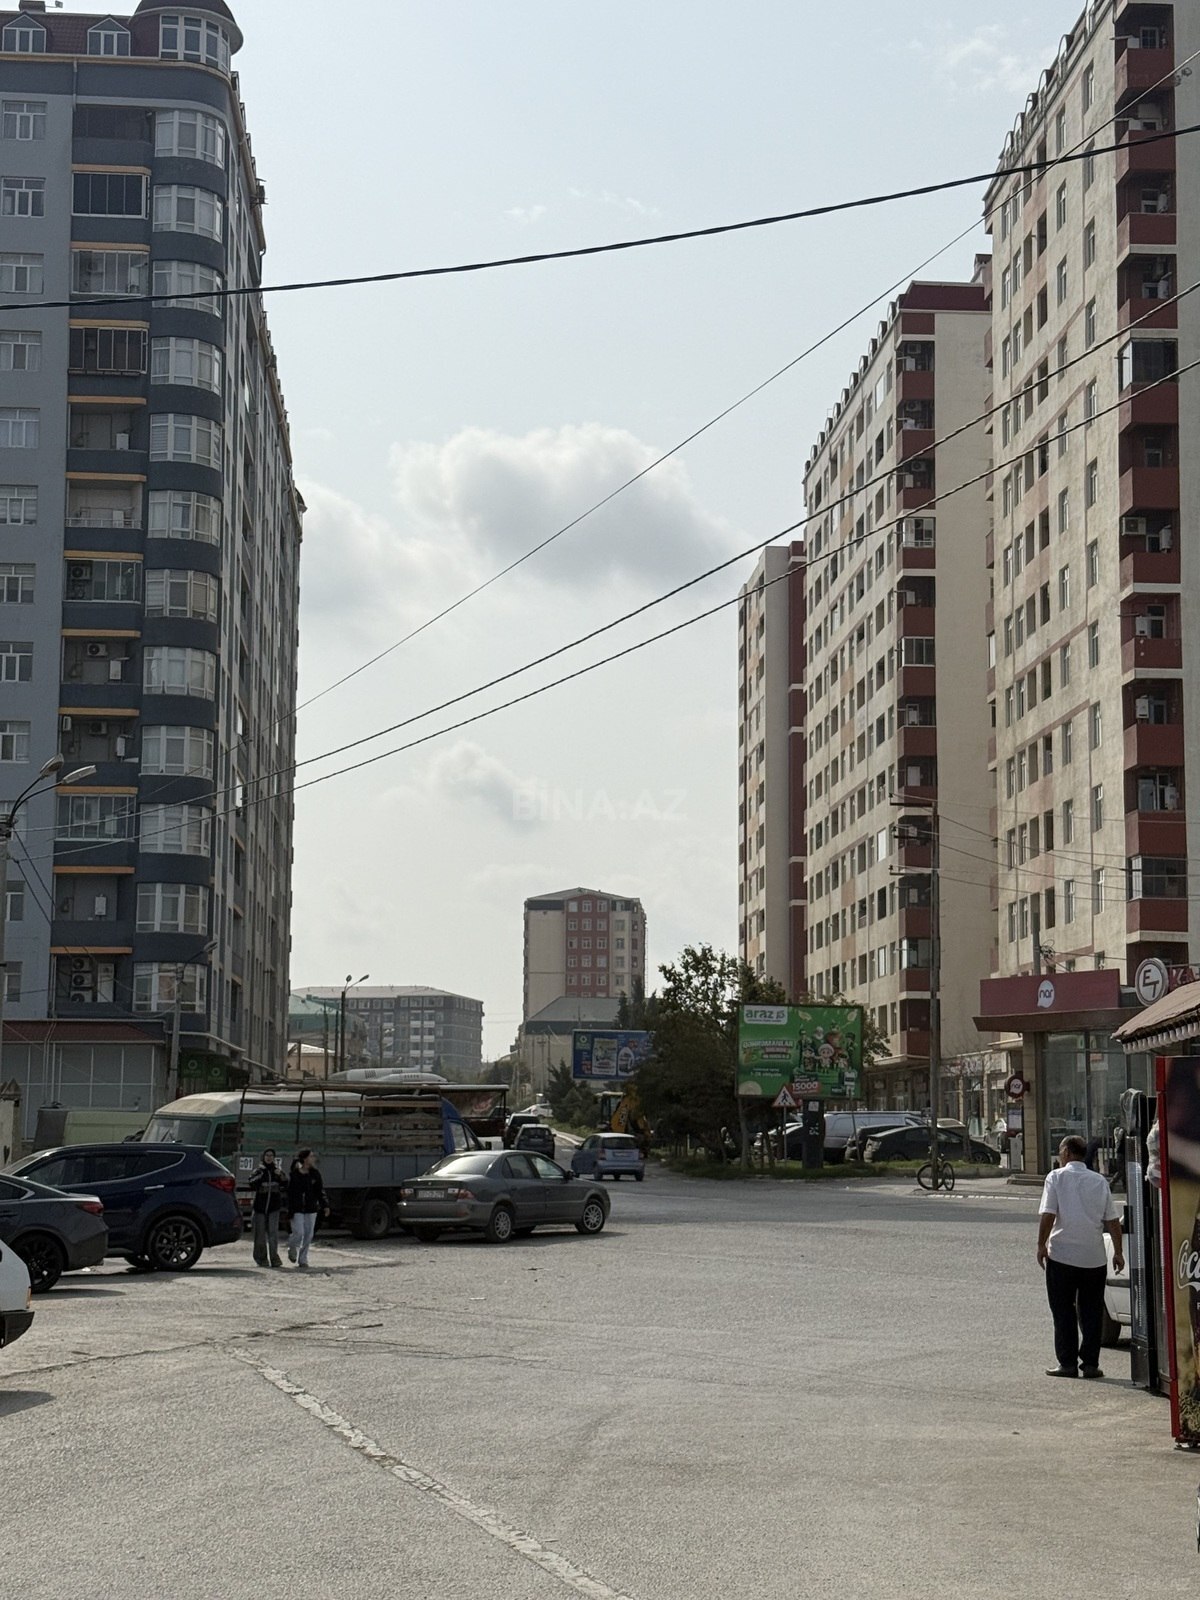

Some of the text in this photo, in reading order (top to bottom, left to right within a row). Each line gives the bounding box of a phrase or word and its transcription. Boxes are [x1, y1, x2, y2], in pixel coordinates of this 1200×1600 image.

[1039, 988, 1054, 999] nar
[745, 1009, 774, 1019] araz
[792, 1081, 818, 1091] 15000
